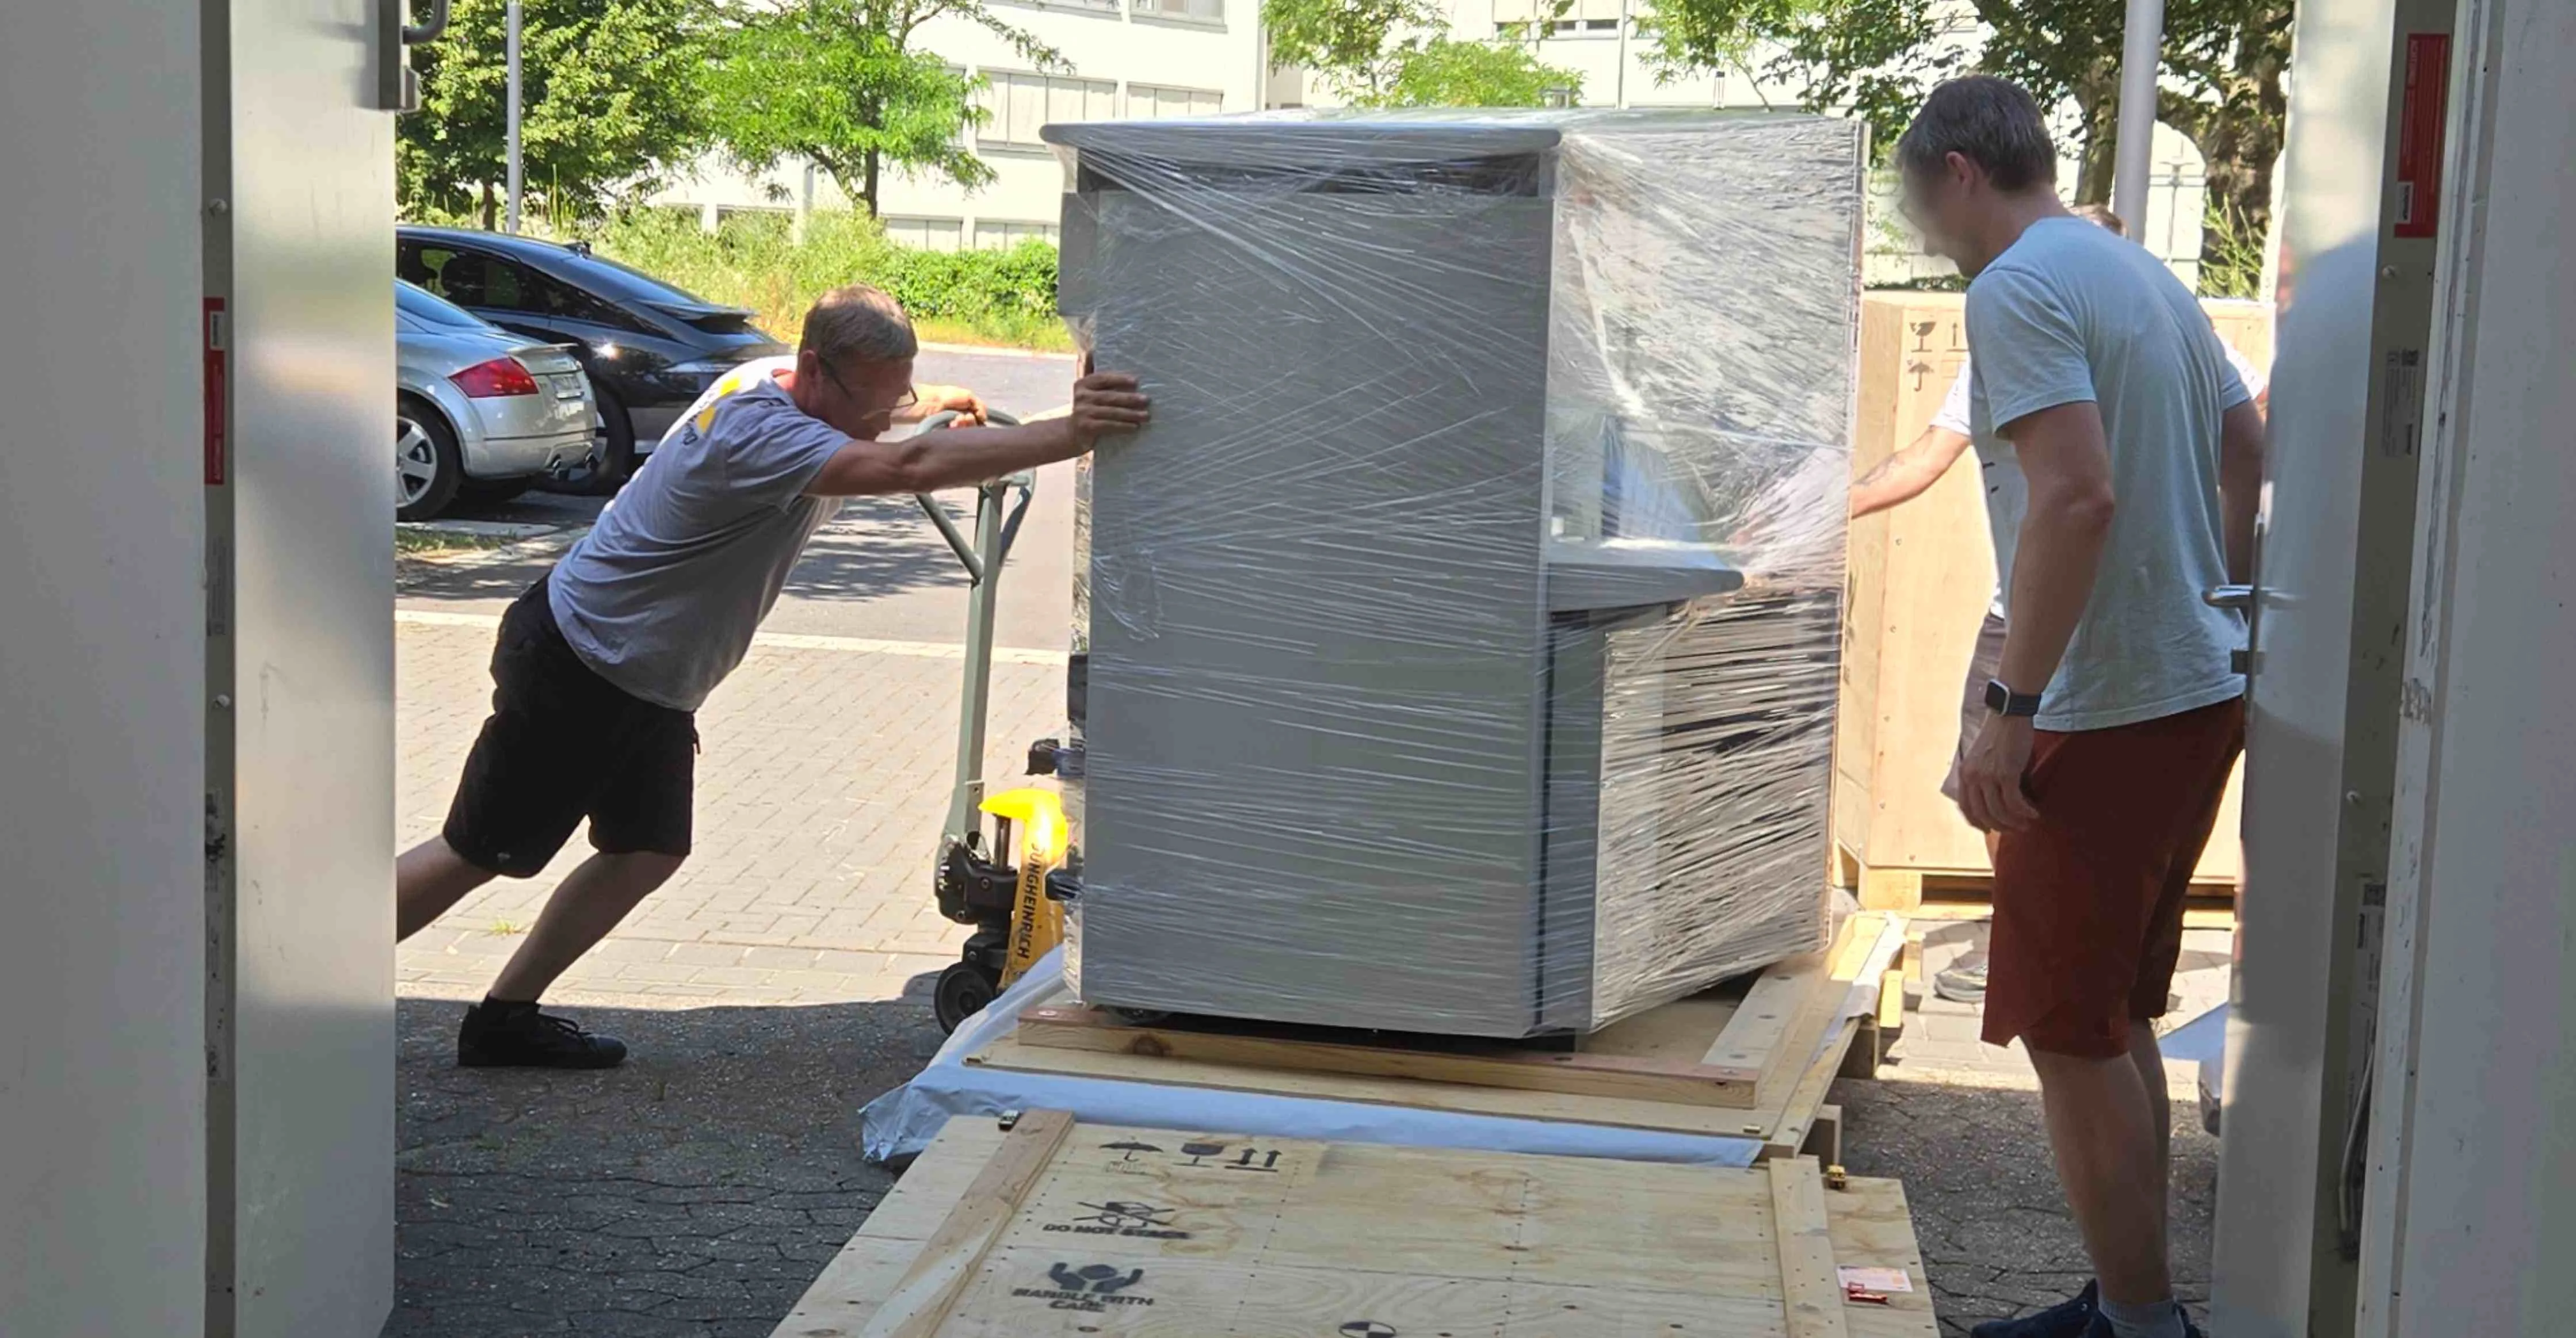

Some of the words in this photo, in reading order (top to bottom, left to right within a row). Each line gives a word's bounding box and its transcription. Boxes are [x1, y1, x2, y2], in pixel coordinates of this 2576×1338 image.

[1017, 843, 1045, 959] JUNGHEINRICH
[1042, 1224, 1071, 1232] DO
[1074, 1225, 1119, 1234] NOT
[1012, 1289, 1096, 1301] HANDLE
[1100, 1295, 1155, 1306] WITH
[1049, 1300, 1106, 1312] CARE
